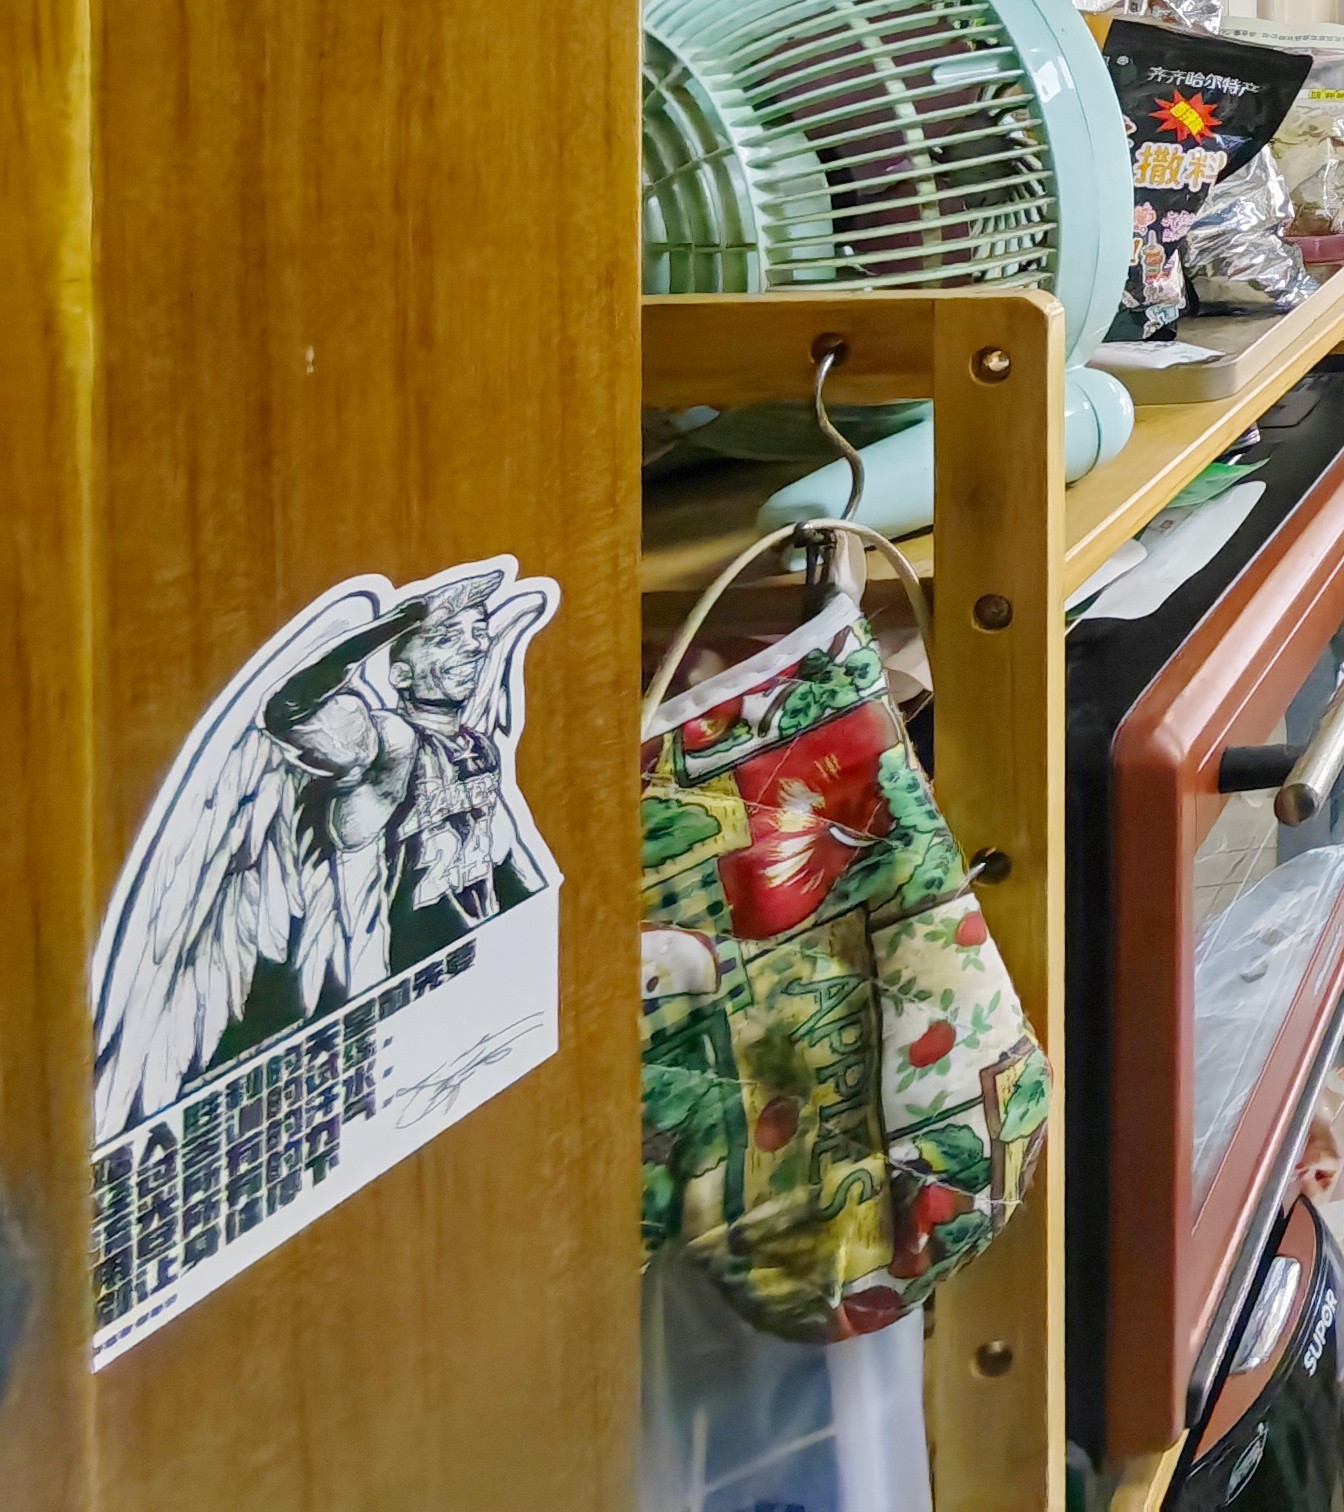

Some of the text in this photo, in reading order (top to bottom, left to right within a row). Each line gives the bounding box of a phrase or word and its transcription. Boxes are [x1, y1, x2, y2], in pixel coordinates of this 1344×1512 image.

[1146, 66, 1261, 97] 齐齐哈尔特产
[780, 973, 881, 1222] APPLES
[1303, 1288, 1338, 1378] SUPOR
